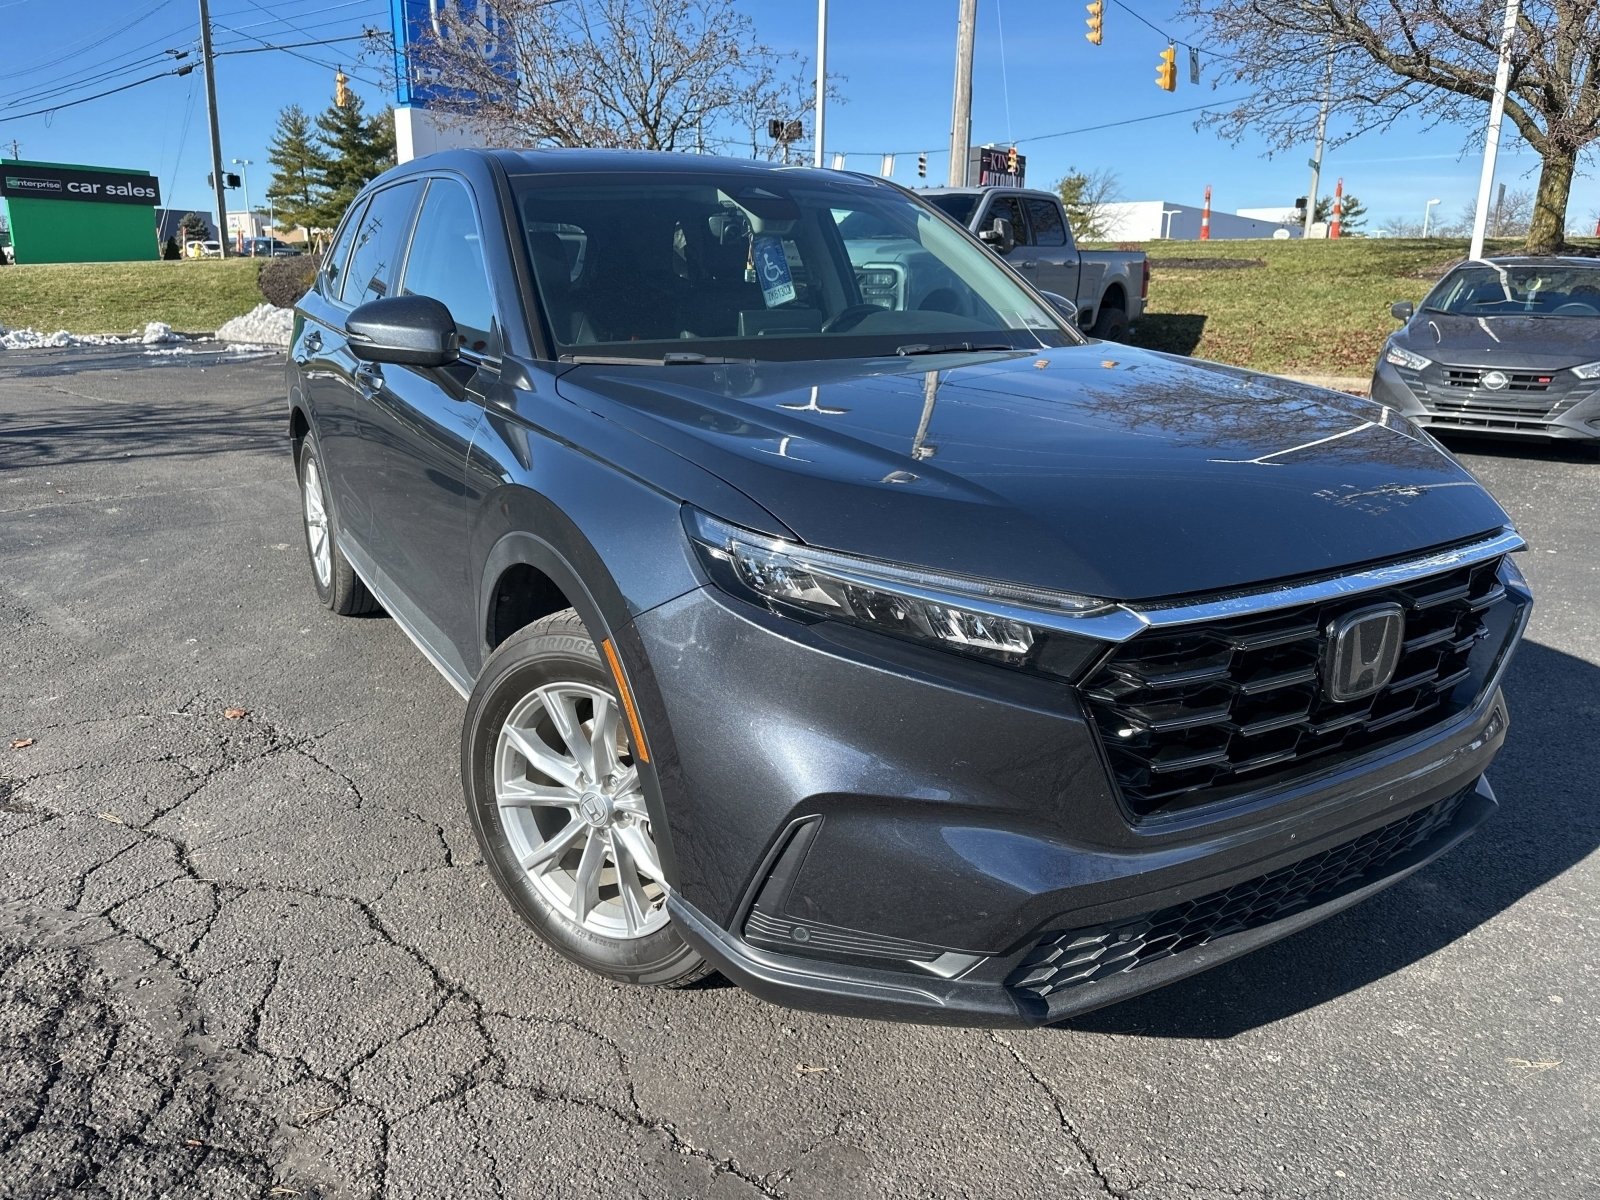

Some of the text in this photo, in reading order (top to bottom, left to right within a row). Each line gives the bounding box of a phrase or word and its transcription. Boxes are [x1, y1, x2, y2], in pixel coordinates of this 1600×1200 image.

[8, 179, 156, 198] enterprise car sales
[534, 637, 598, 656] BRIDGE
